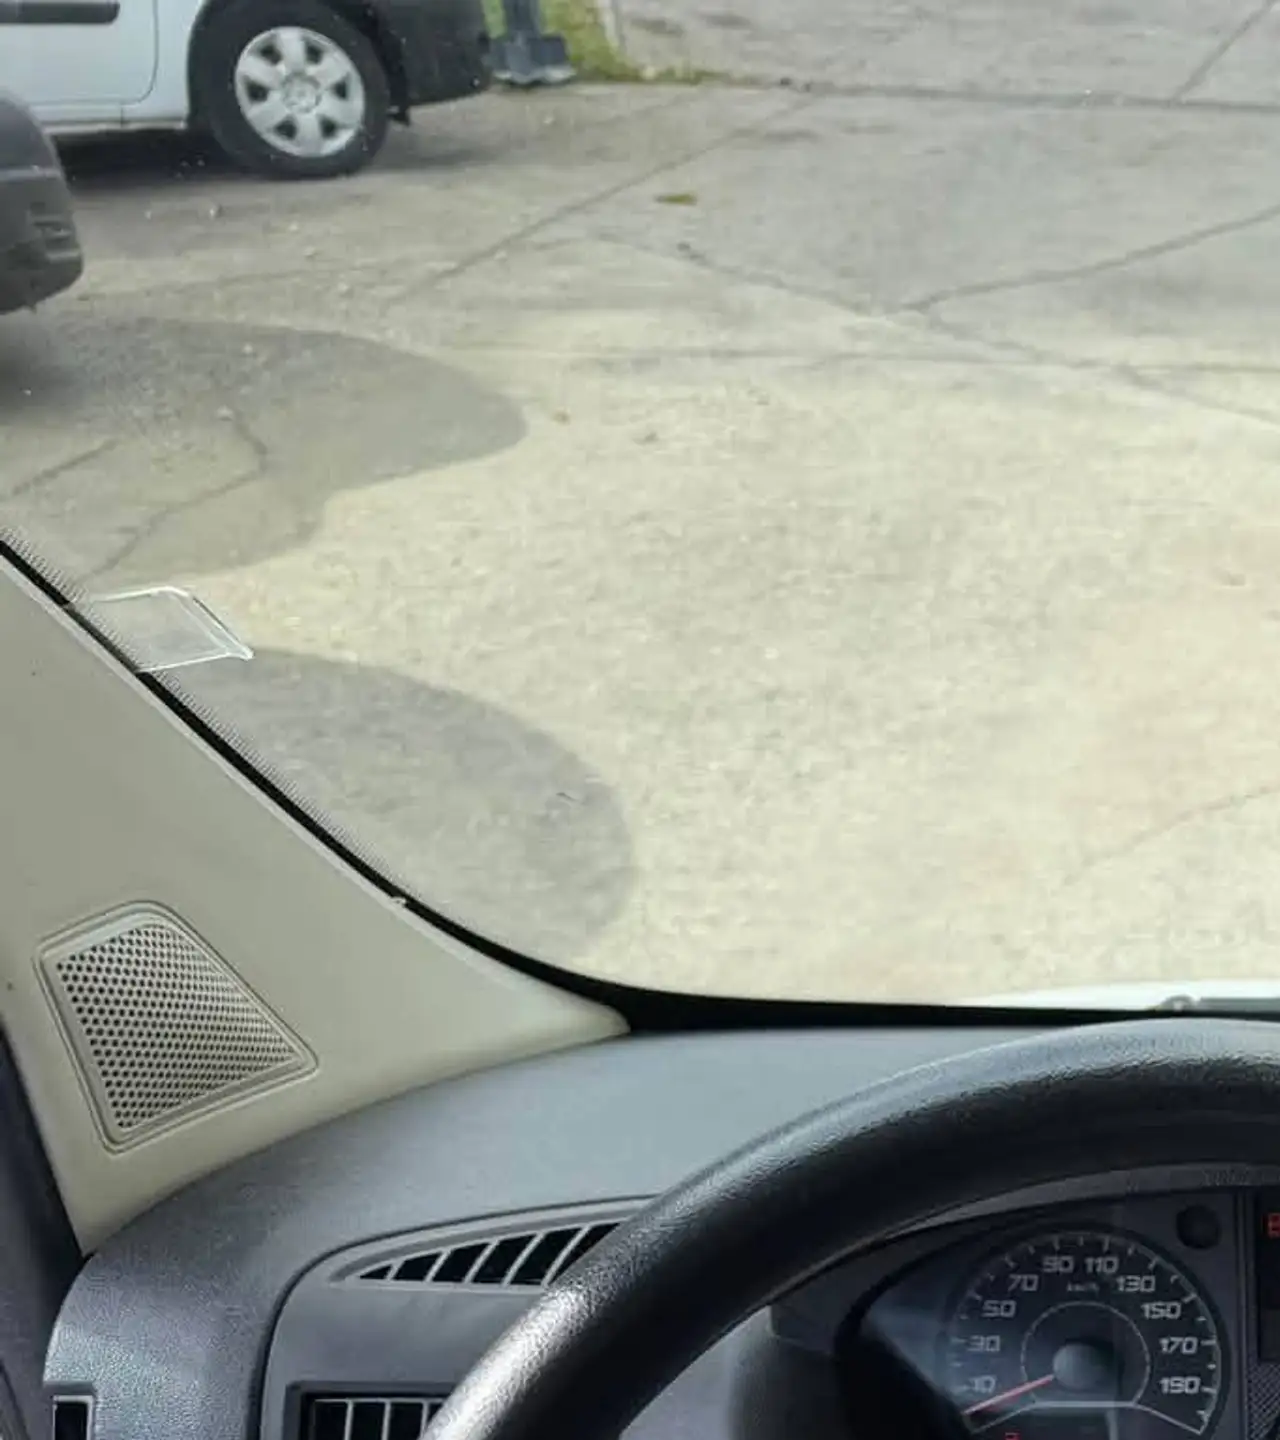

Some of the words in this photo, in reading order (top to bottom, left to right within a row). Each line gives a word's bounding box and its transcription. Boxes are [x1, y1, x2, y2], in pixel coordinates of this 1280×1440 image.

[1042, 1255, 1075, 1273] 90
[1085, 1256, 1120, 1274] 110
[1007, 1274, 1040, 1292] 70
[1116, 1275, 1157, 1293] 130
[981, 1300, 1018, 1319] 50
[1141, 1302, 1182, 1320] 150
[966, 1335, 1001, 1354] 30
[1159, 1336, 1199, 1354] 170
[971, 1375, 997, 1394] 10
[1159, 1376, 1201, 1394] 190
